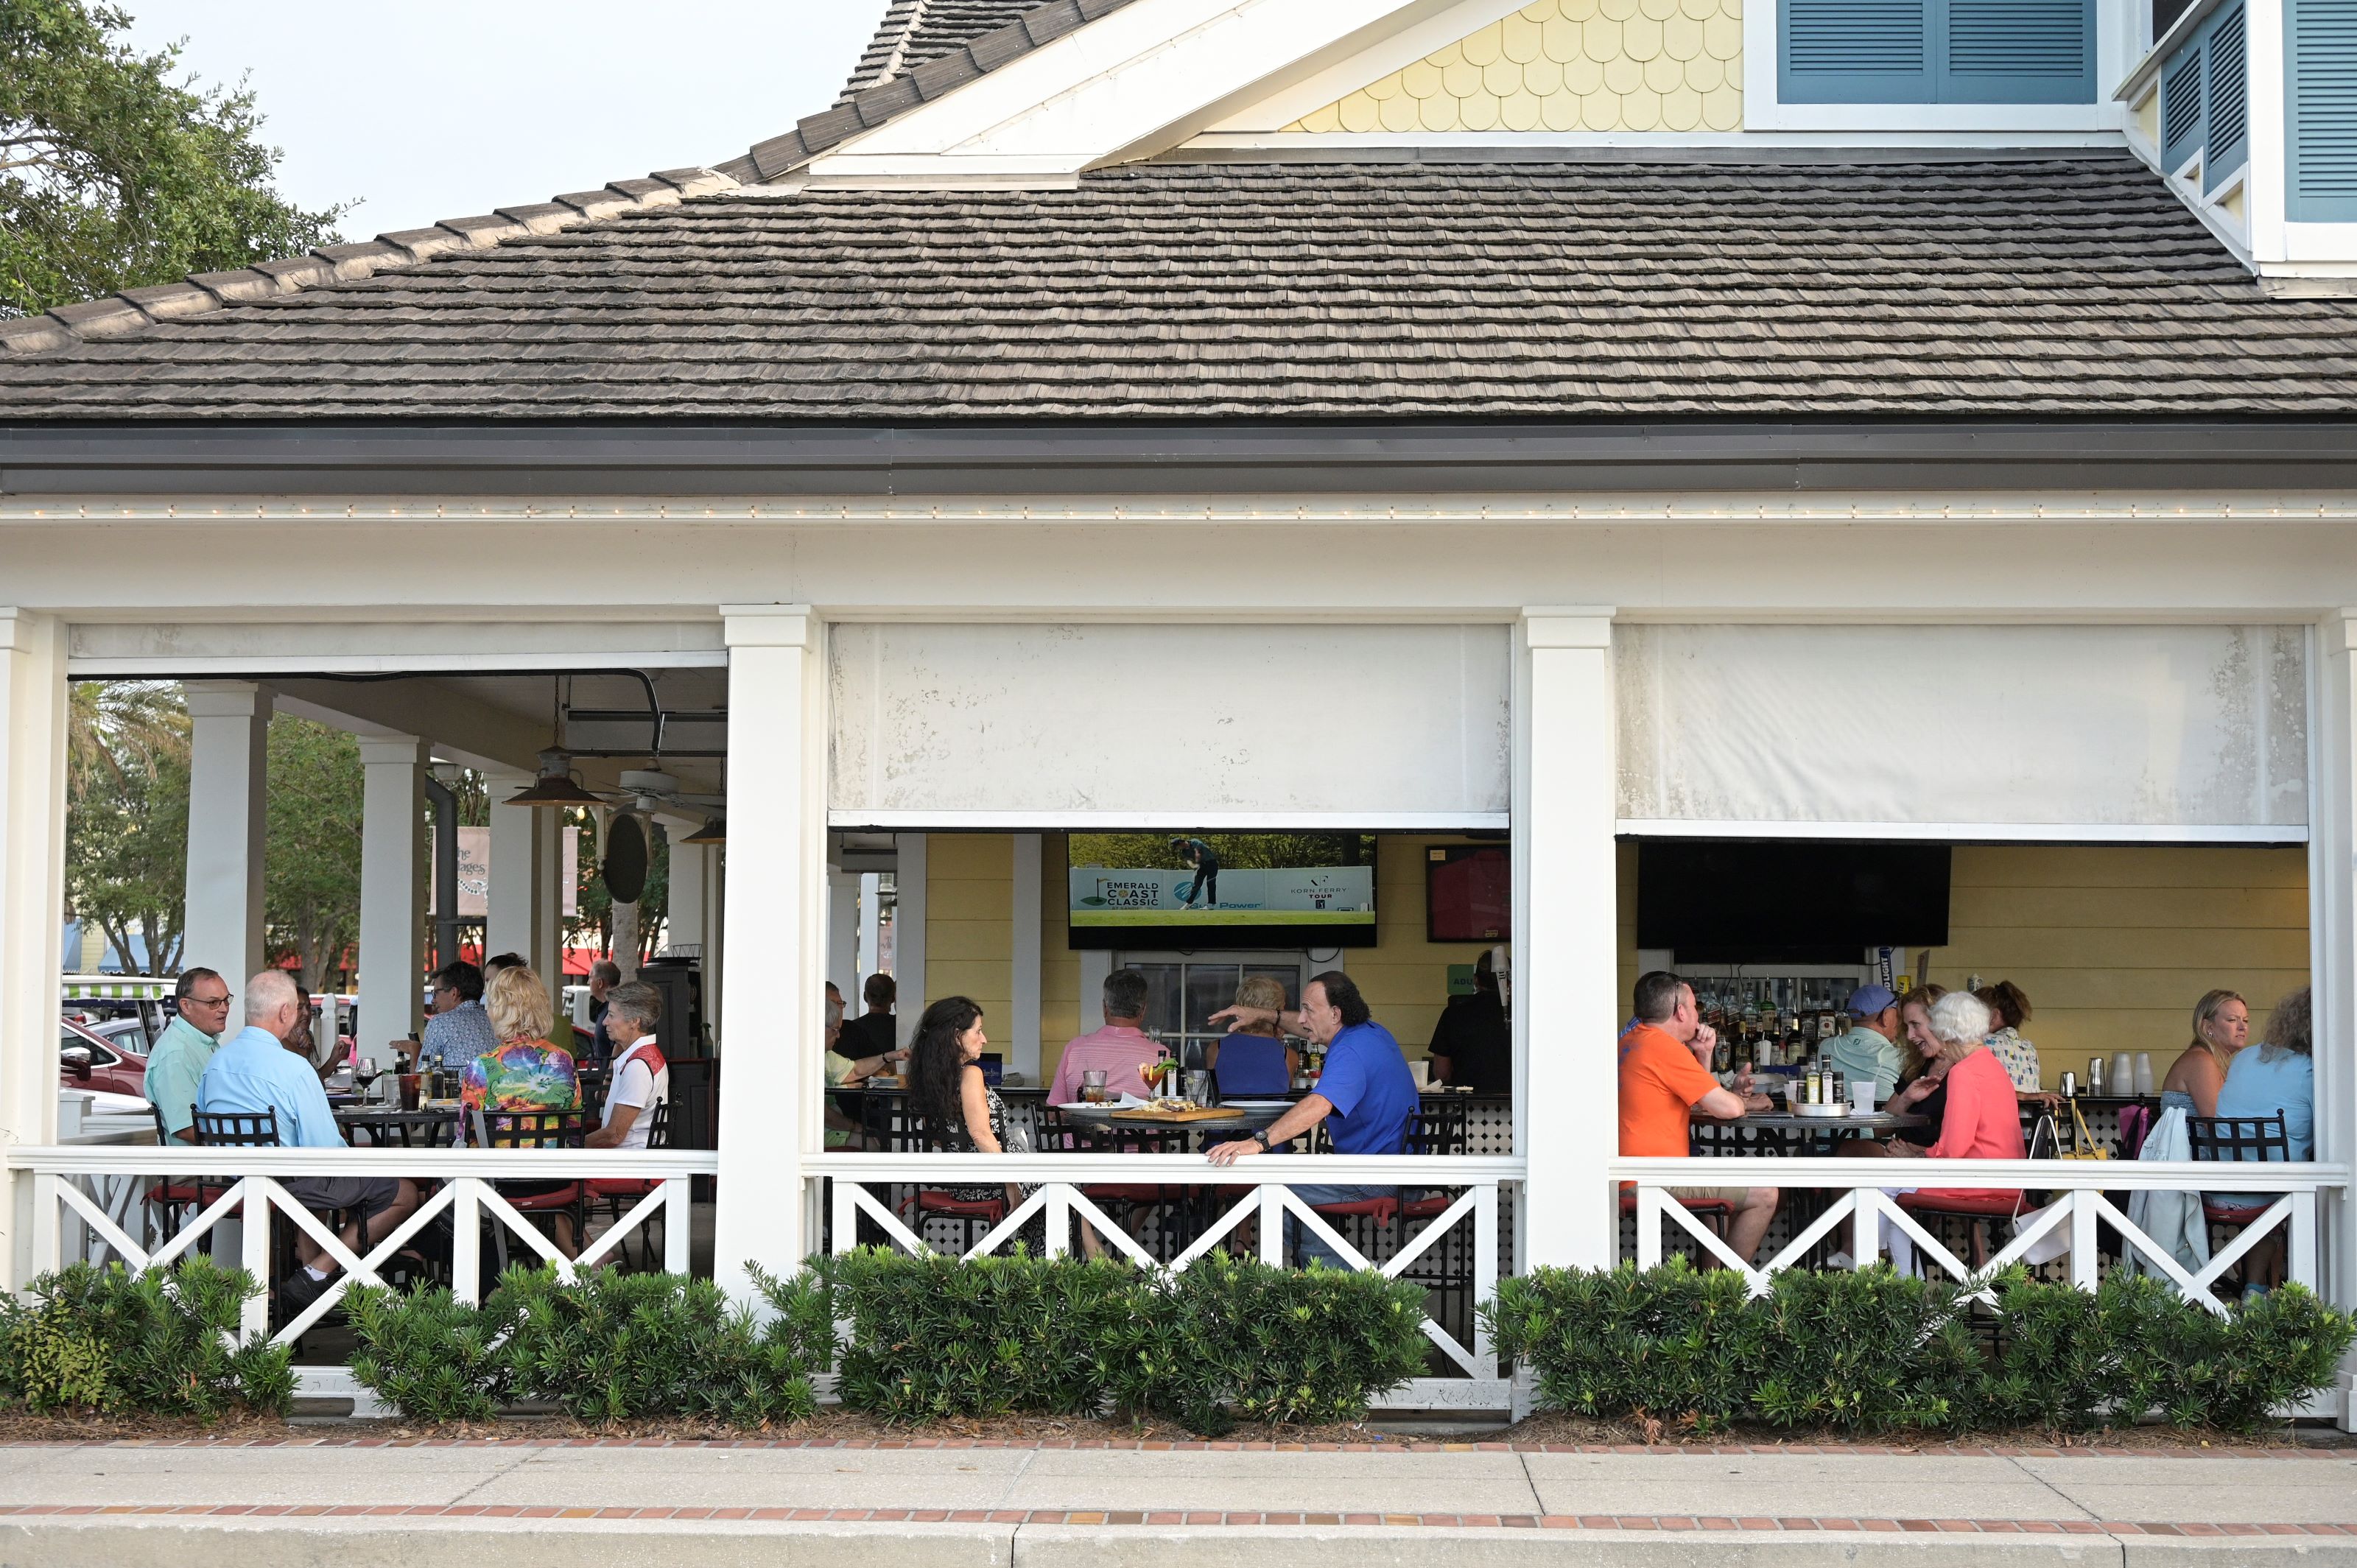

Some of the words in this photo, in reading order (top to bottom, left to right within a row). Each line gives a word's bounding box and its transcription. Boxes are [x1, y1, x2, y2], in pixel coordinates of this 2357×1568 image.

[457, 846, 471, 860] he
[1106, 882, 1159, 890] EMERALD
[1107, 898, 1159, 906] CLASSIC
[1880, 957, 1890, 981] LIGHT
